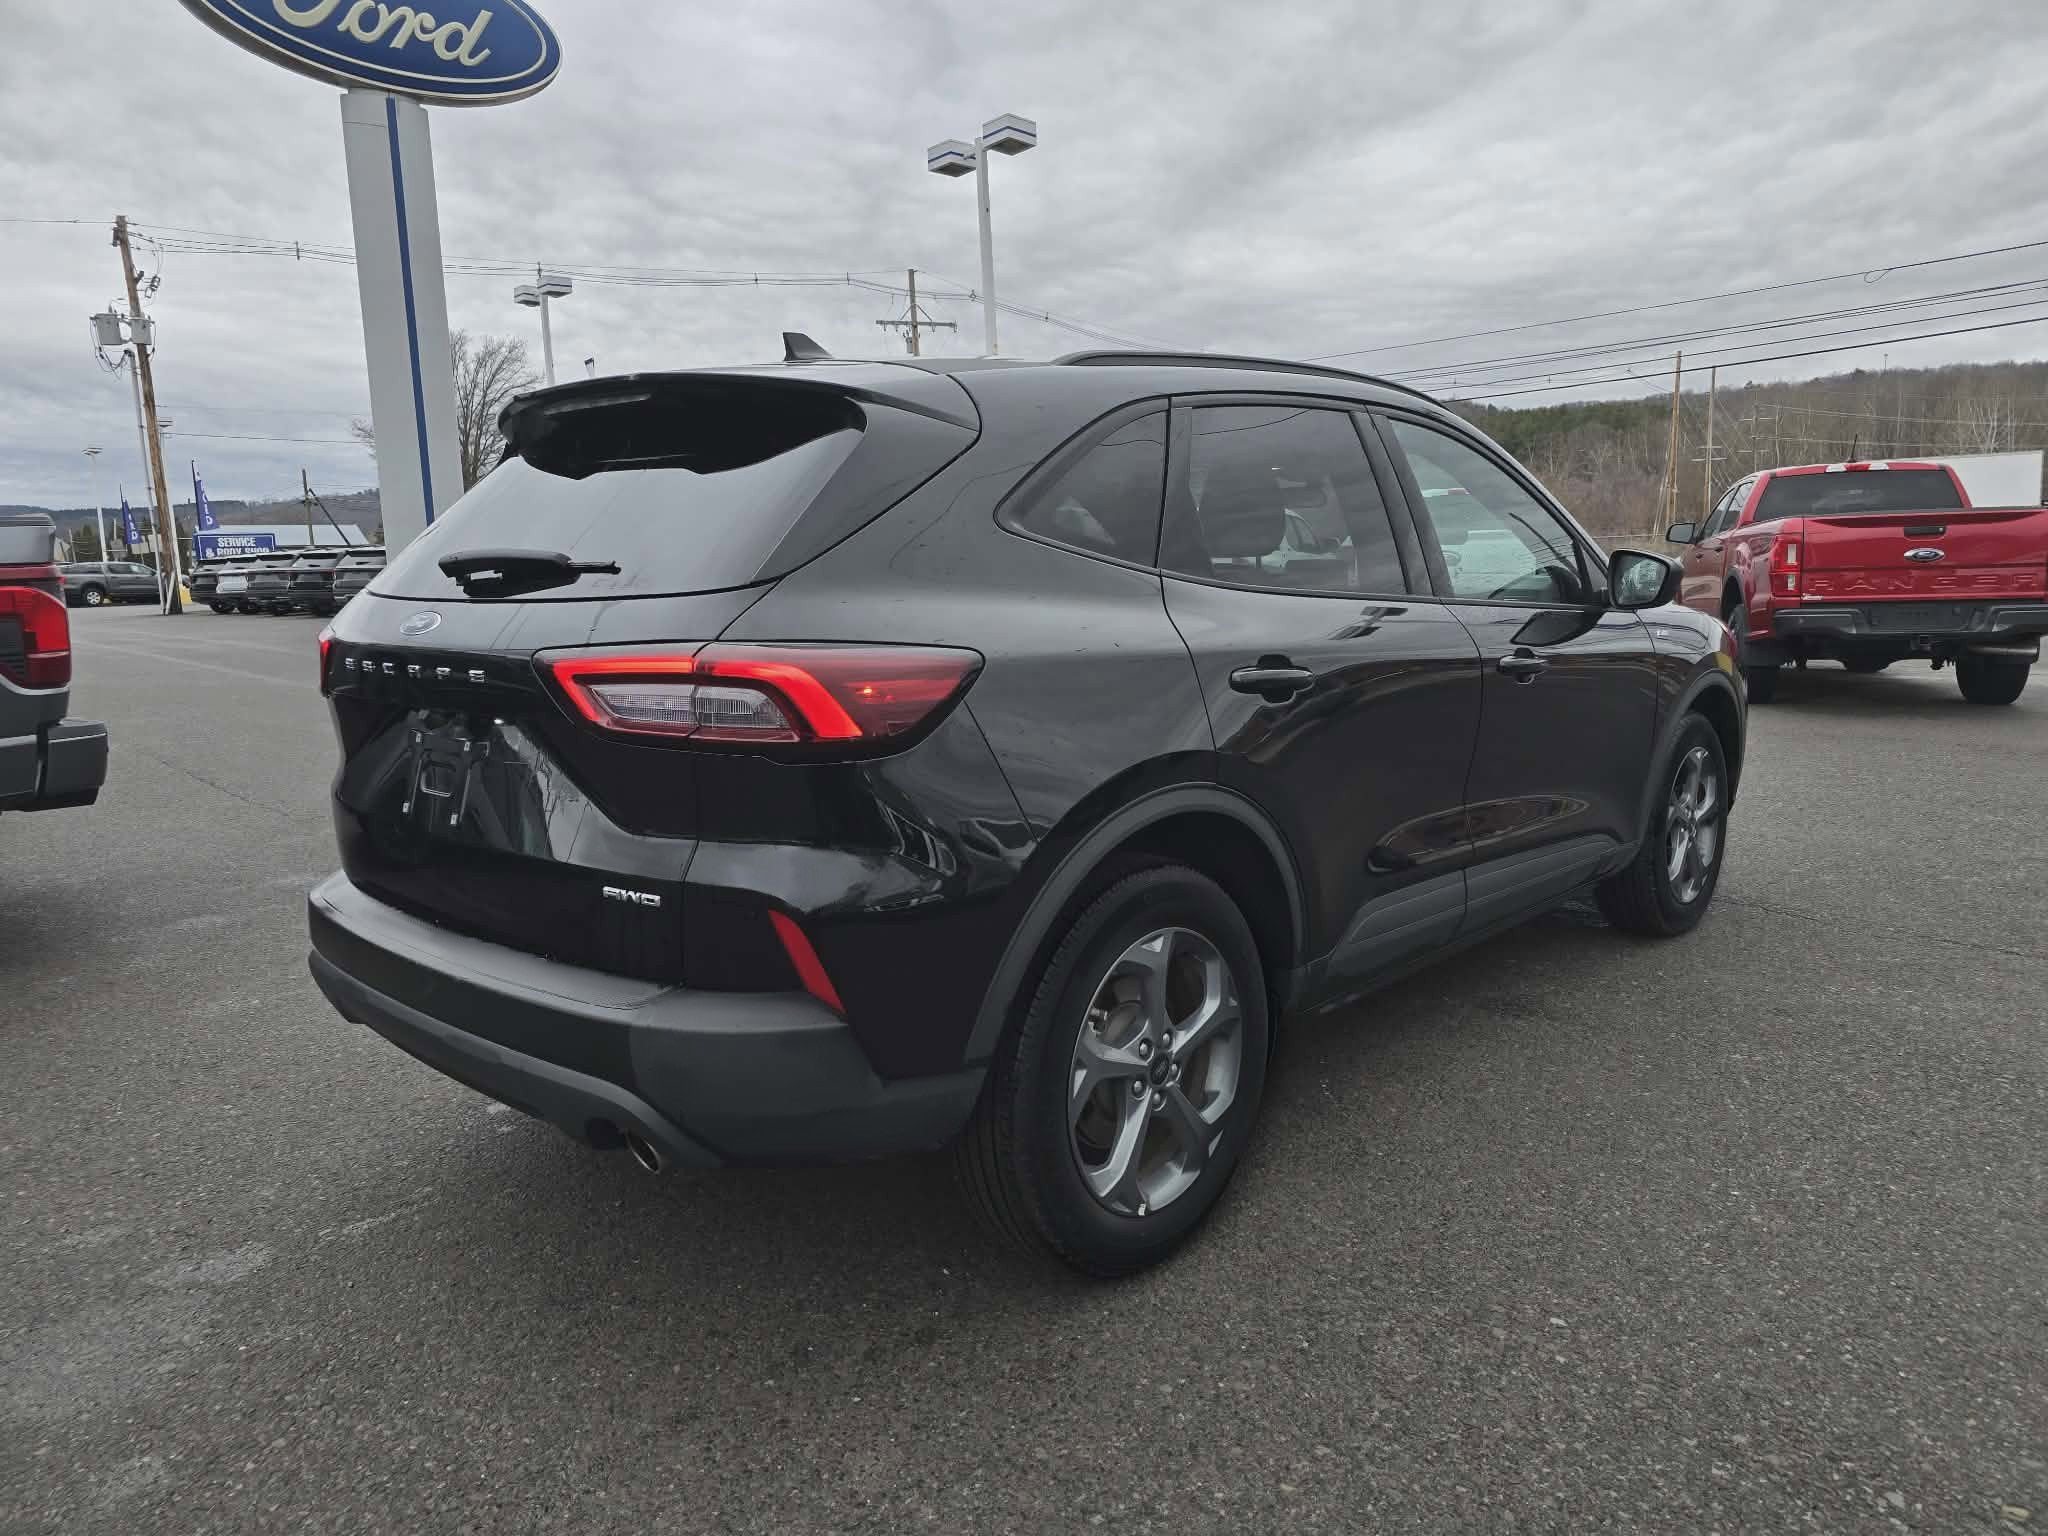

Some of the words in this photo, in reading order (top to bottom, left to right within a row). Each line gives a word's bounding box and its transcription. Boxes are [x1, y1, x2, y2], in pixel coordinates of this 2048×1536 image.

[217, 537, 256, 547] SERVICE
[1808, 572, 2038, 591] RANGER
[344, 657, 486, 683] ESCAPE
[602, 886, 661, 907] AWD
